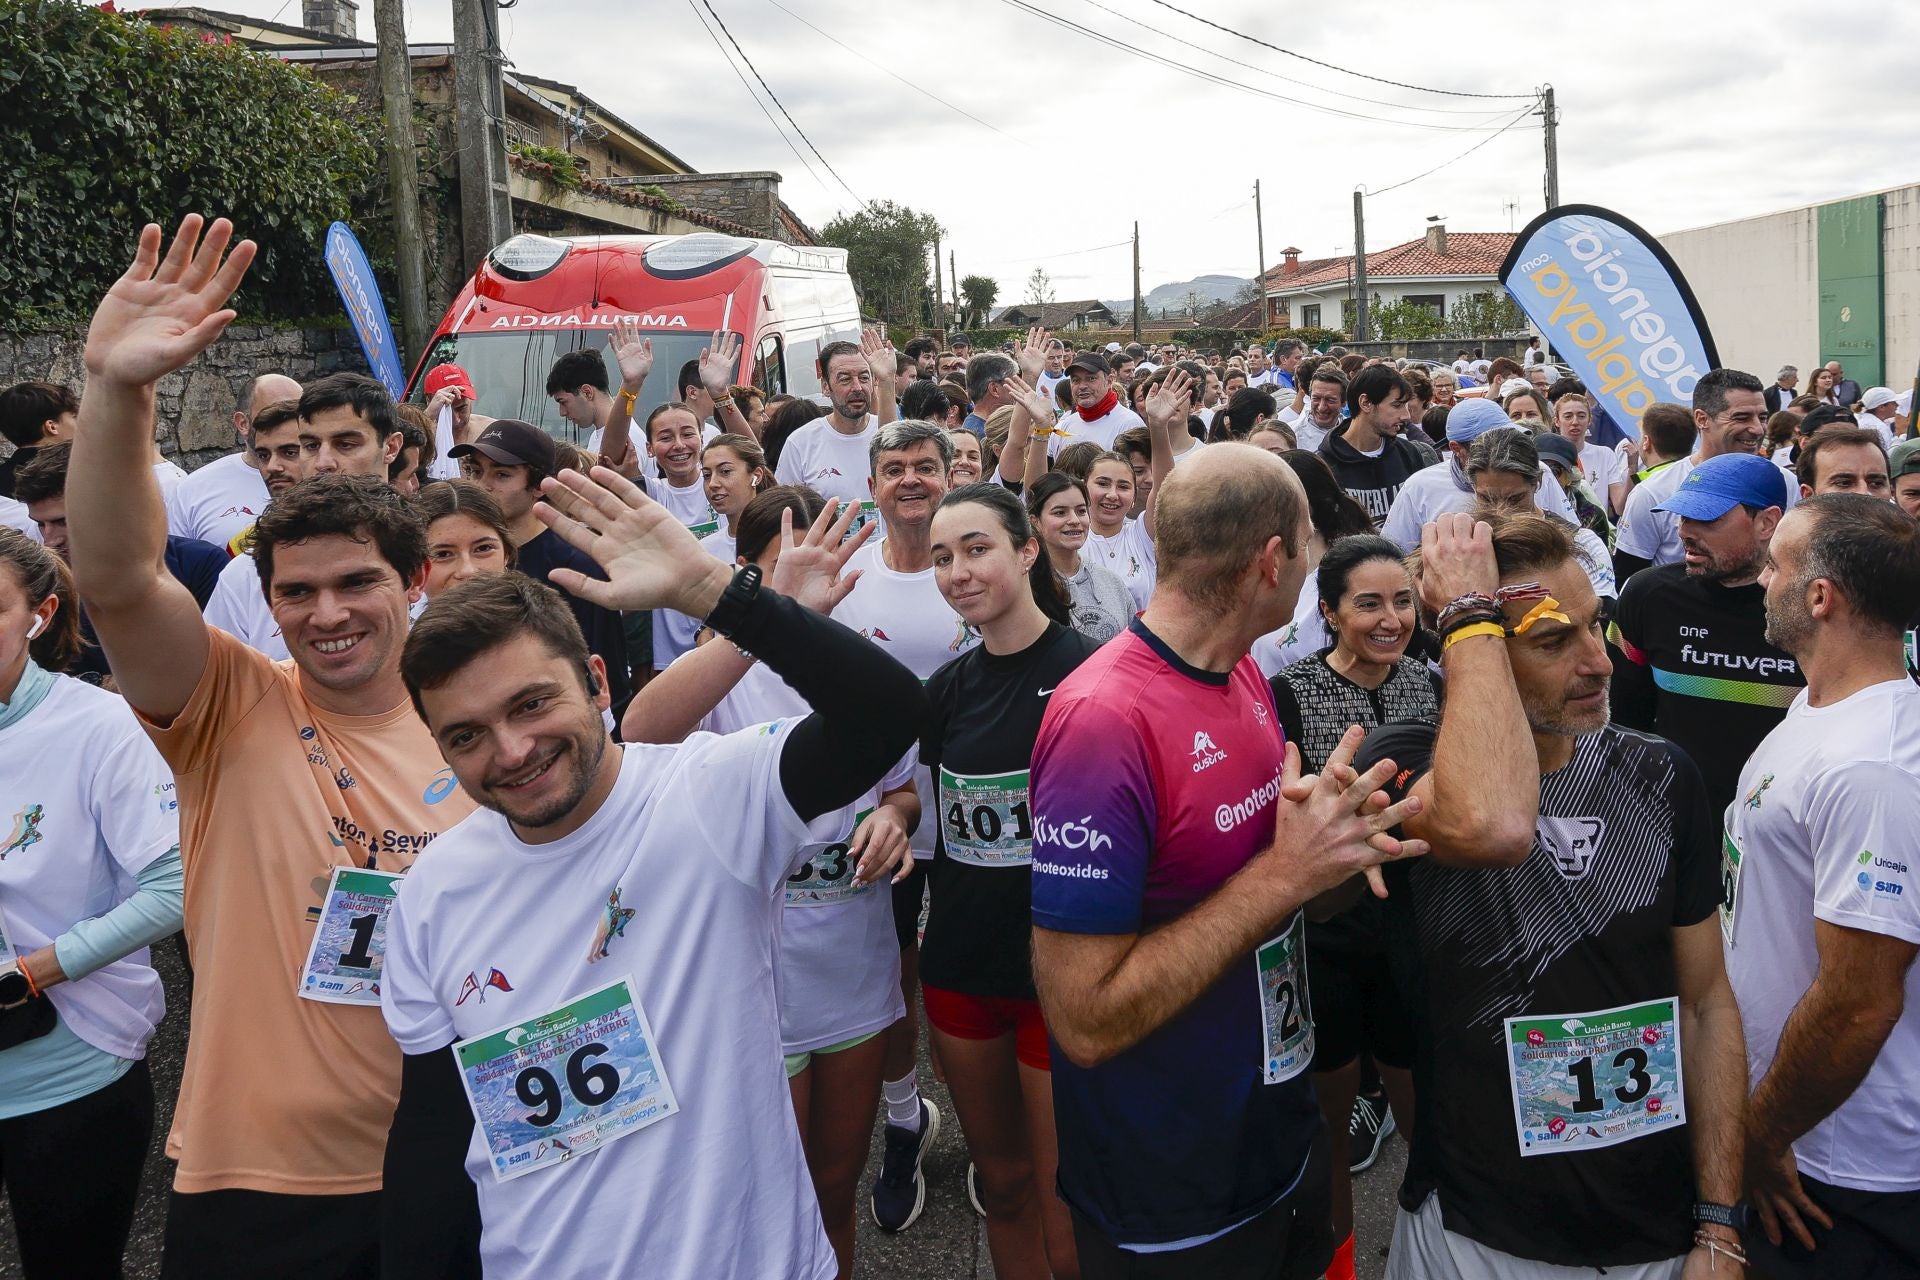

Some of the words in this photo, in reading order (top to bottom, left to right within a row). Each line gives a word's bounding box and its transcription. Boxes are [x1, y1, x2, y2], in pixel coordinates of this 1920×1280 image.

[1680, 625, 1709, 639] one
[947, 800, 1033, 843] 401
[1033, 814, 1113, 852] Xixón
[1032, 857, 1110, 880] @noteoxides
[318, 979, 344, 990] sam
[487, 1053, 522, 1069] Carrera
[596, 1008, 622, 1026] 2024
[552, 1016, 578, 1031] Banco
[1584, 1024, 1611, 1034] Unicaja
[1611, 1021, 1631, 1031] Banco
[518, 1057, 534, 1069] con
[535, 1037, 584, 1065] PROYECTO
[585, 1016, 630, 1044] HOMBRE
[1521, 1050, 1569, 1060] Solidarios
[1570, 1048, 1588, 1057] con
[1588, 1039, 1632, 1055] PROYECTO
[1633, 1030, 1668, 1045] HORE
[1280, 1055, 1295, 1070] sam
[514, 1042, 621, 1128] 96
[1567, 1047, 1653, 1114] 13
[1645, 1112, 1672, 1126] laplaya
[508, 1151, 531, 1165] sam
[621, 1105, 657, 1126] laplaya
